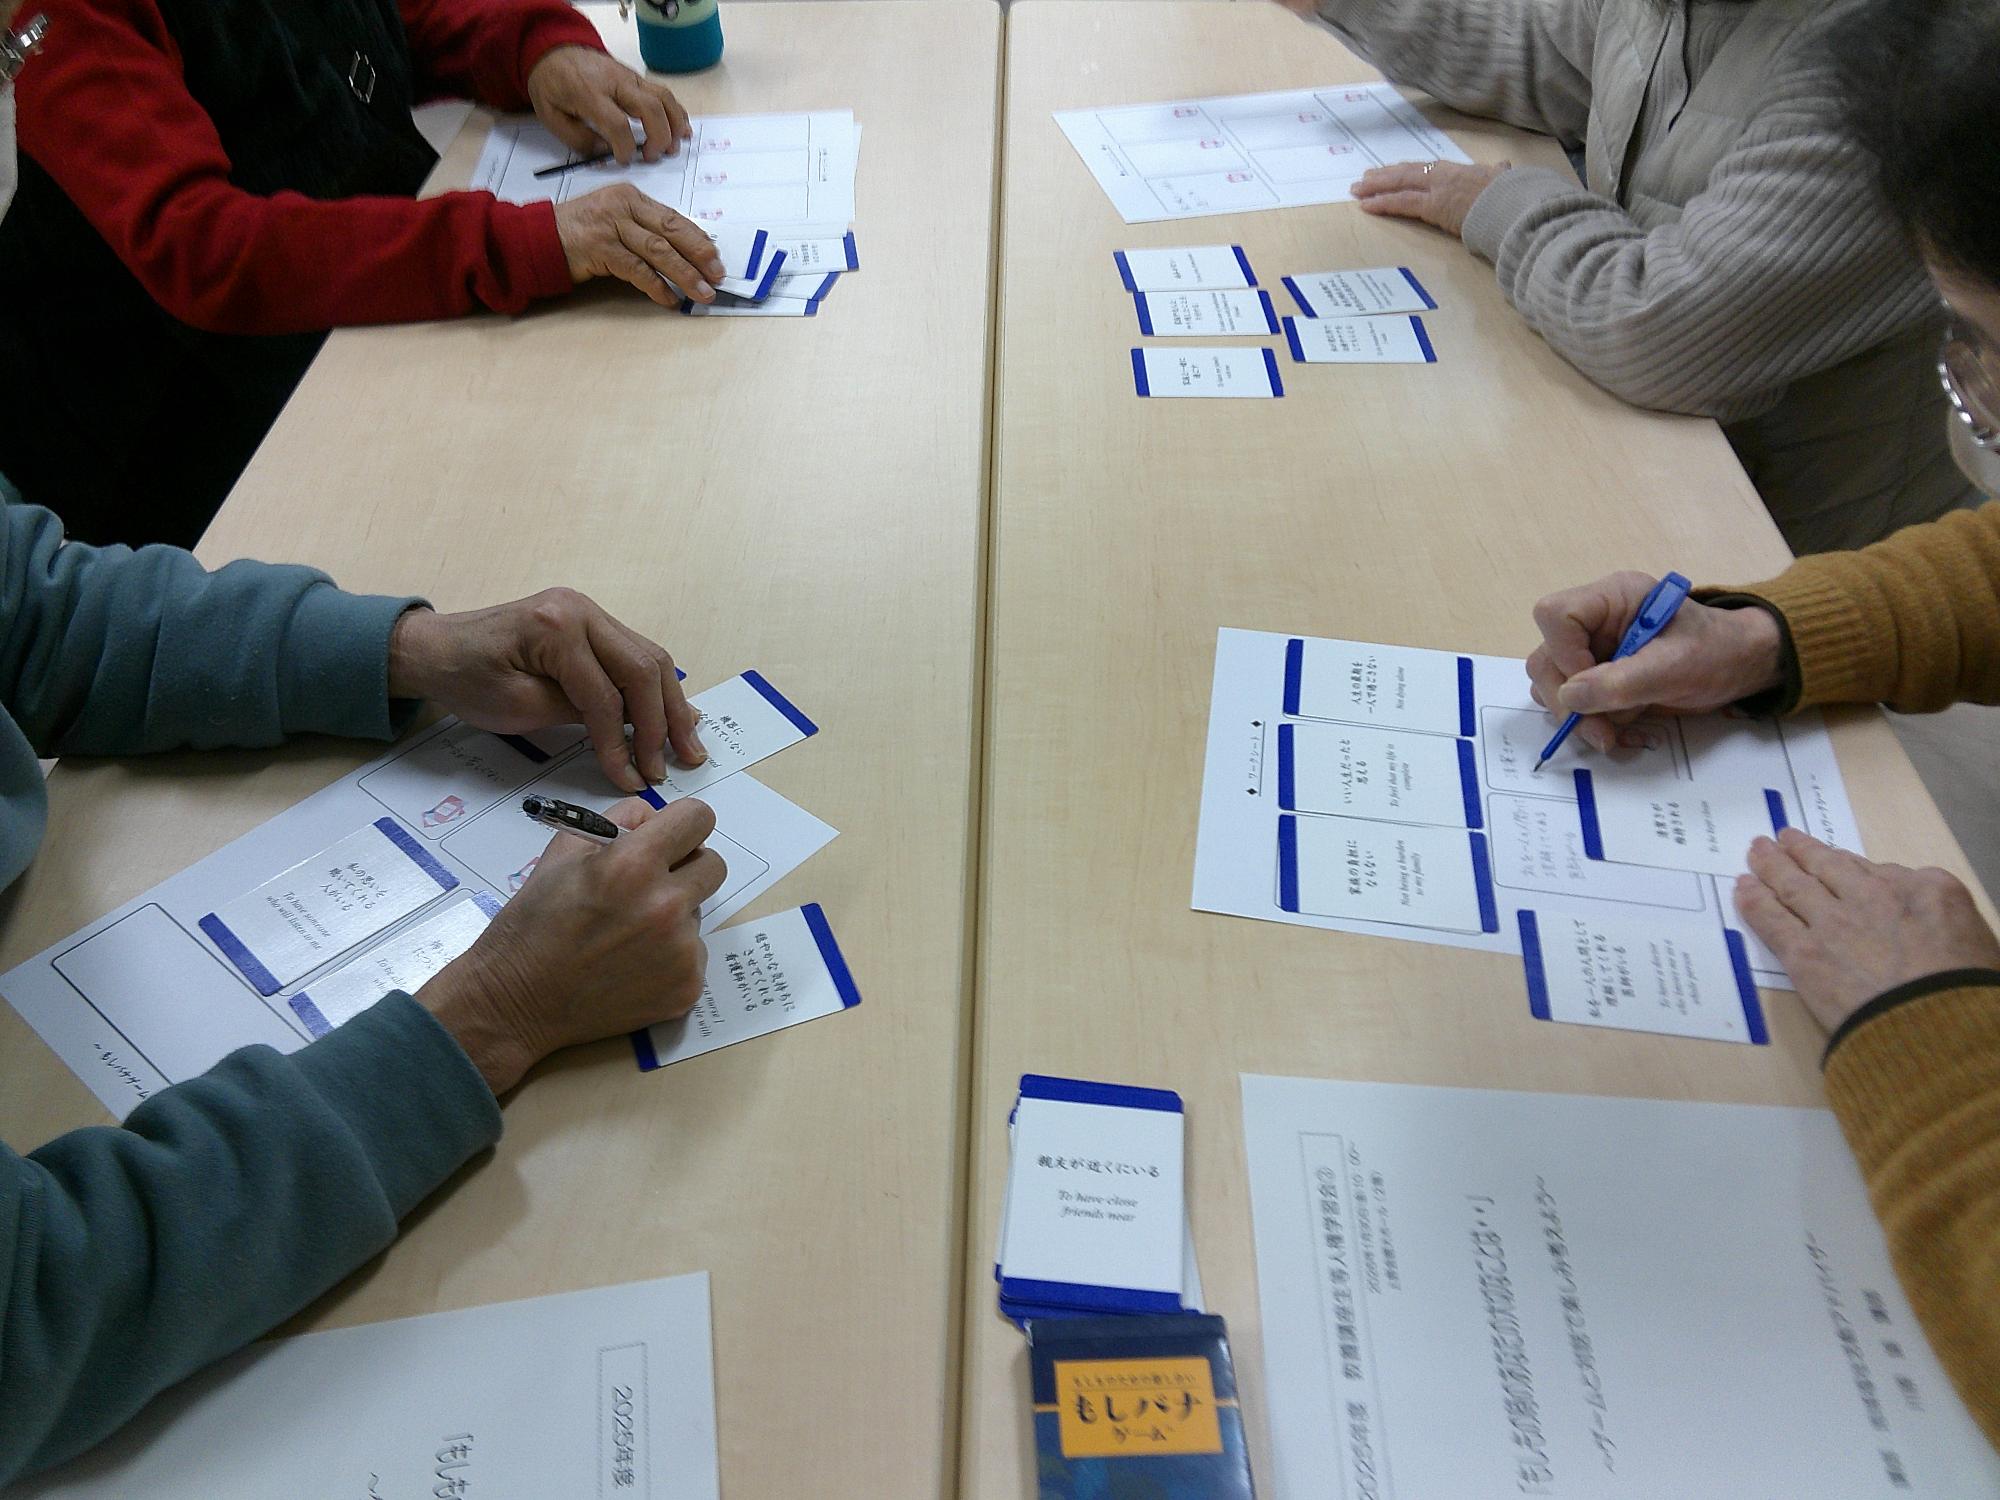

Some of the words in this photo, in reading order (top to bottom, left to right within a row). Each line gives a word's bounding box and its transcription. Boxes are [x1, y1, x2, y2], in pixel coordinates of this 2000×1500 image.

[1350, 662, 1362, 704] 人生の最期を
[1366, 655, 1377, 713] 一人で過ごさない
[698, 713, 746, 756] ながれていない
[719, 715, 744, 736] 機器に
[1339, 739, 1352, 804] いい人生だったと
[1355, 760, 1368, 784] 思える
[346, 862, 387, 898] 私の思いを
[1346, 840, 1362, 895] 家族の負担に
[1363, 850, 1378, 887] ならない
[319, 883, 354, 911] 人がいる
[725, 952, 757, 1012] 看護師がいる
[743, 949, 774, 1006] させてくれる
[755, 933, 795, 1012] 穏やかな気持ちに
[706, 996, 720, 1017] nurse
[698, 1020, 712, 1037] with
[1038, 1155, 1159, 1177] 親友が近くにいる
[1058, 1189, 1072, 1199] To
[1076, 1192, 1104, 1203] have
[1106, 1196, 1138, 1207] close
[1060, 1206, 1104, 1219] friends
[1071, 1390, 1201, 1423] もしバナ
[611, 1384, 635, 1489] 2025年度
